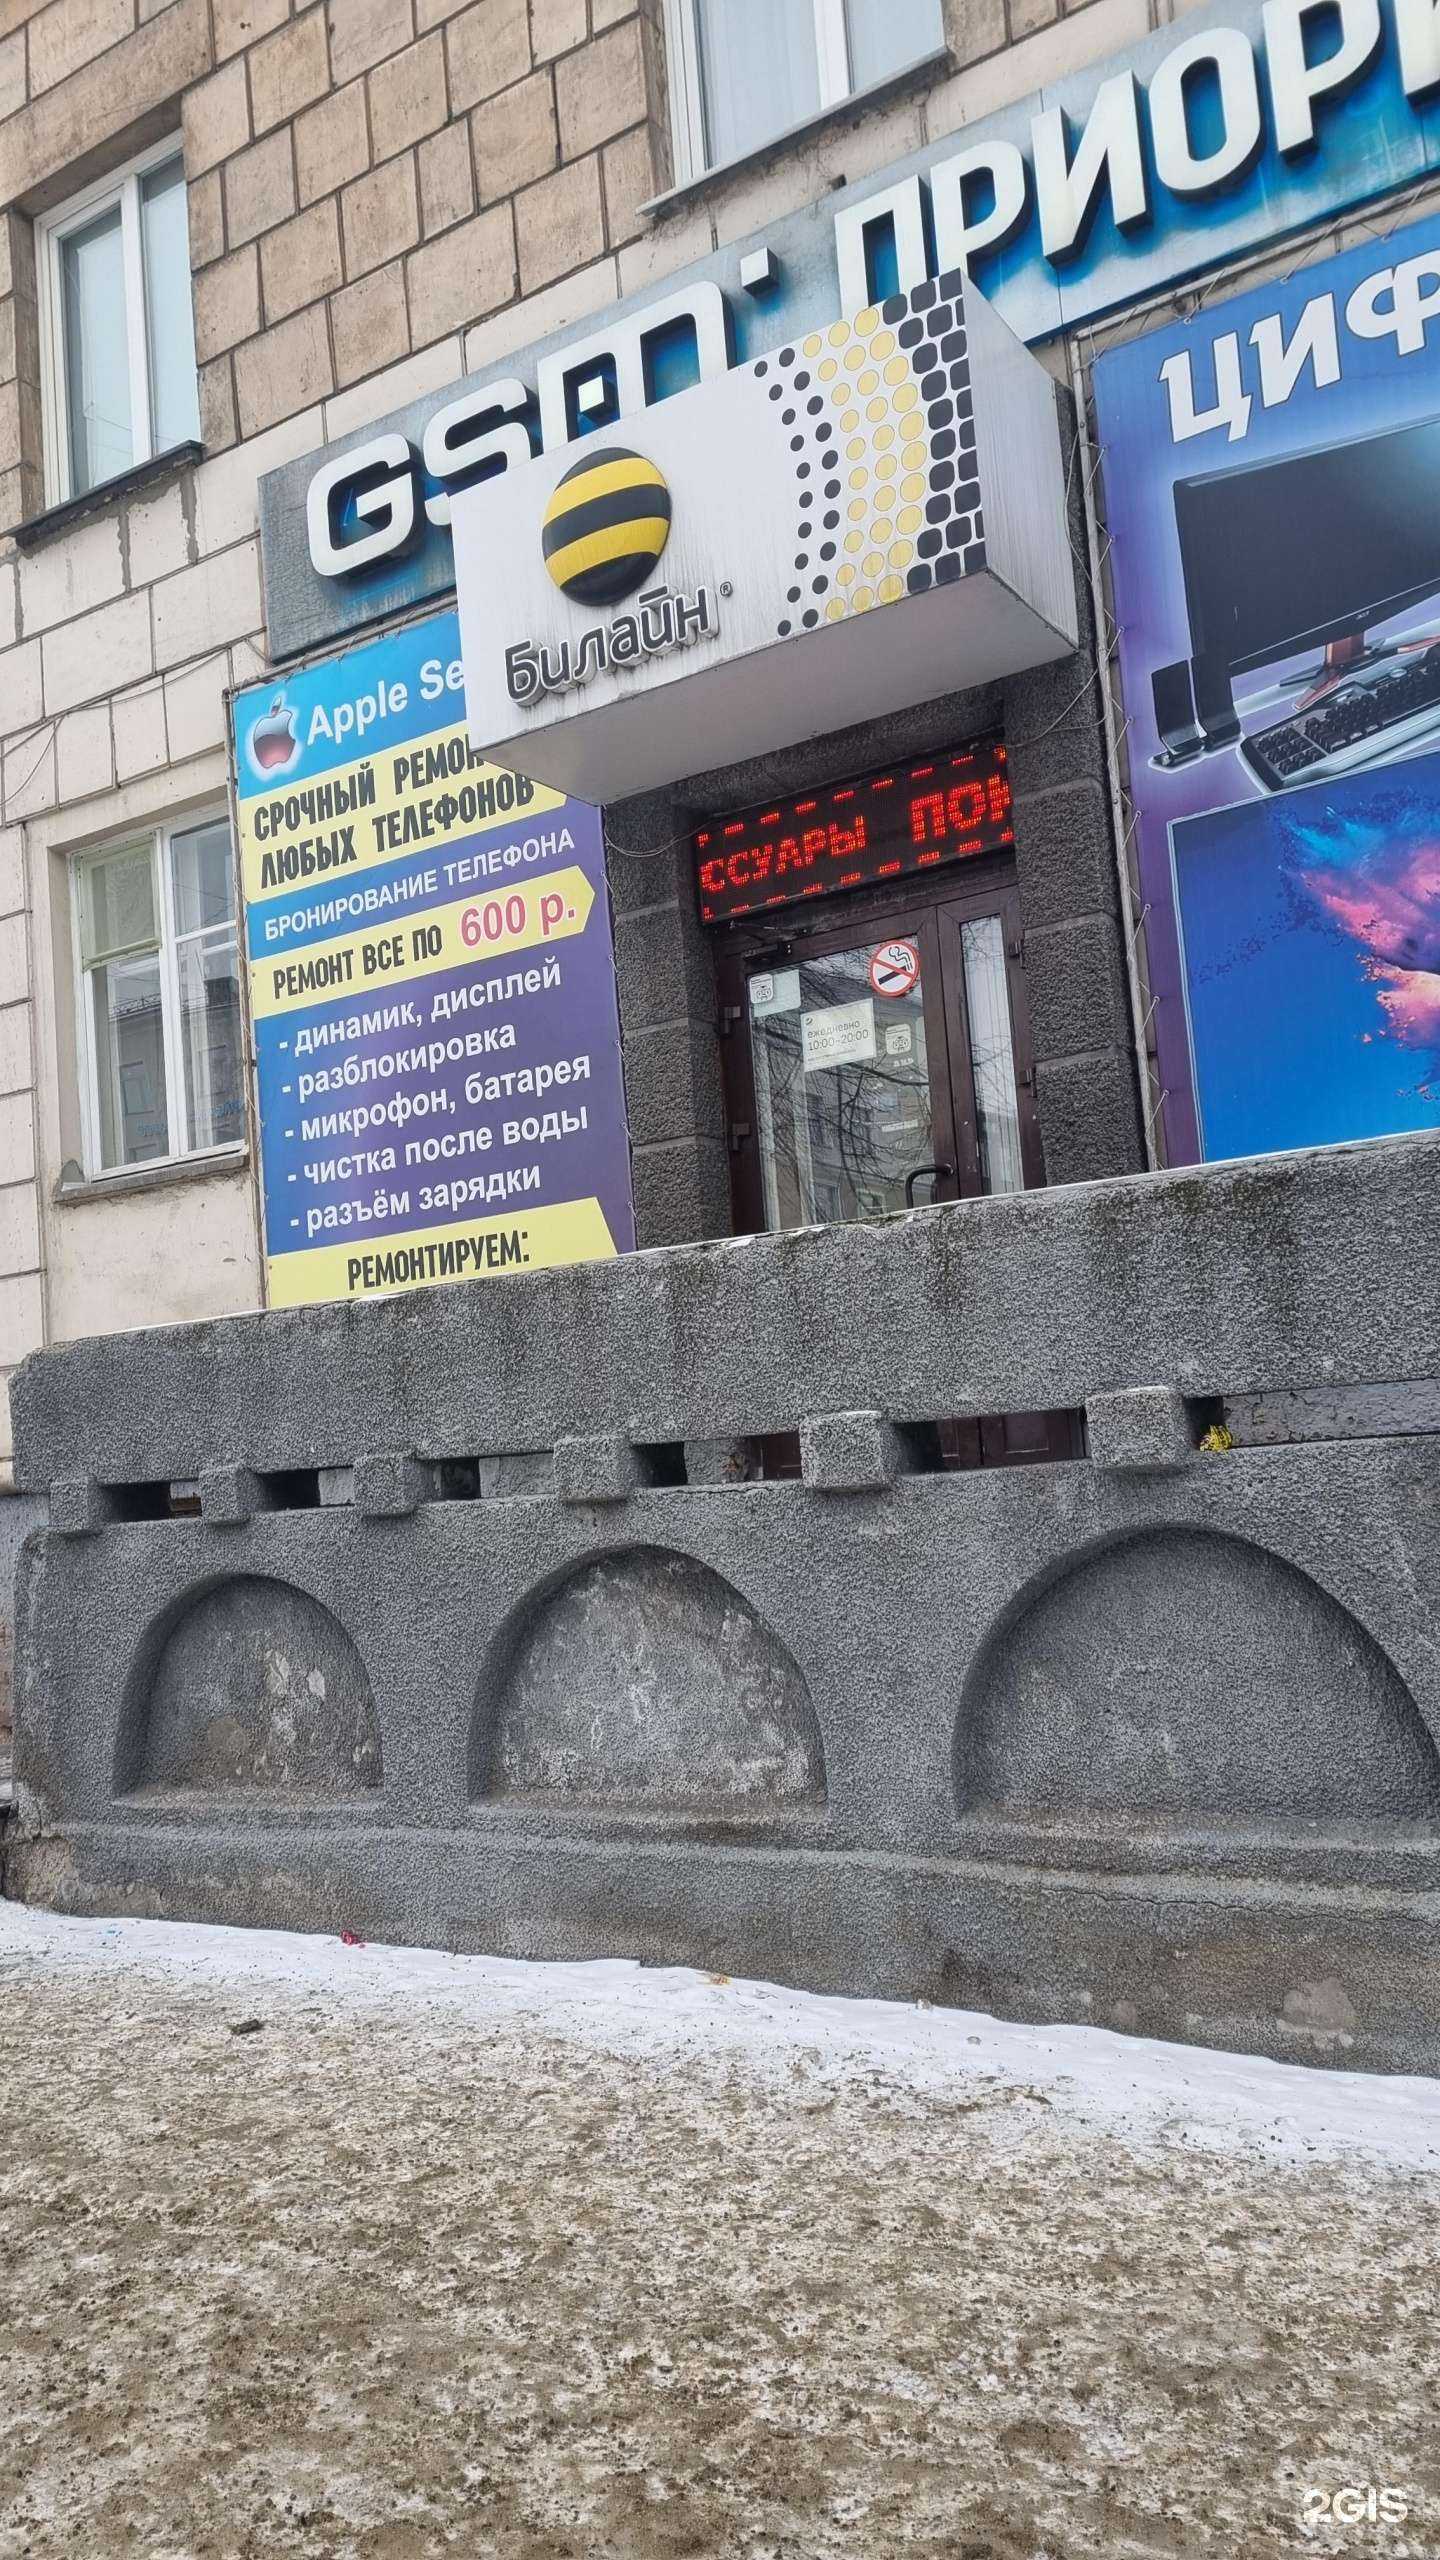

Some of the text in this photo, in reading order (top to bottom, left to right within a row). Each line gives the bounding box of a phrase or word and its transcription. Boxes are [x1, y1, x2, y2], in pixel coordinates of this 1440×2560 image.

[505, 585, 710, 703] Билайн
[307, 684, 408, 746] Apple
[254, 761, 376, 841] СРОЧНЫЙ
[260, 774, 535, 889] ЛЮБЫХ ТЕЛЕФОНОВ
[264, 828, 575, 941] БРОНИРОВАНИЕ ТЕЛЕФОНА
[273, 892, 576, 1000] РЕМОНТ ВСЕ ПО 600 р.
[295, 956, 561, 1057] динамик, дисплей
[808, 1020, 860, 1038] ежедневно
[298, 1024, 517, 1102] разблокировка
[302, 1088, 456, 1141] микрофон,
[465, 1055, 591, 1105] батарея
[303, 1106, 588, 1187] чистка после воды
[307, 1166, 541, 1238] разъём зарядки
[348, 1230, 530, 1291] РЕМОНТИРУЕМ:
